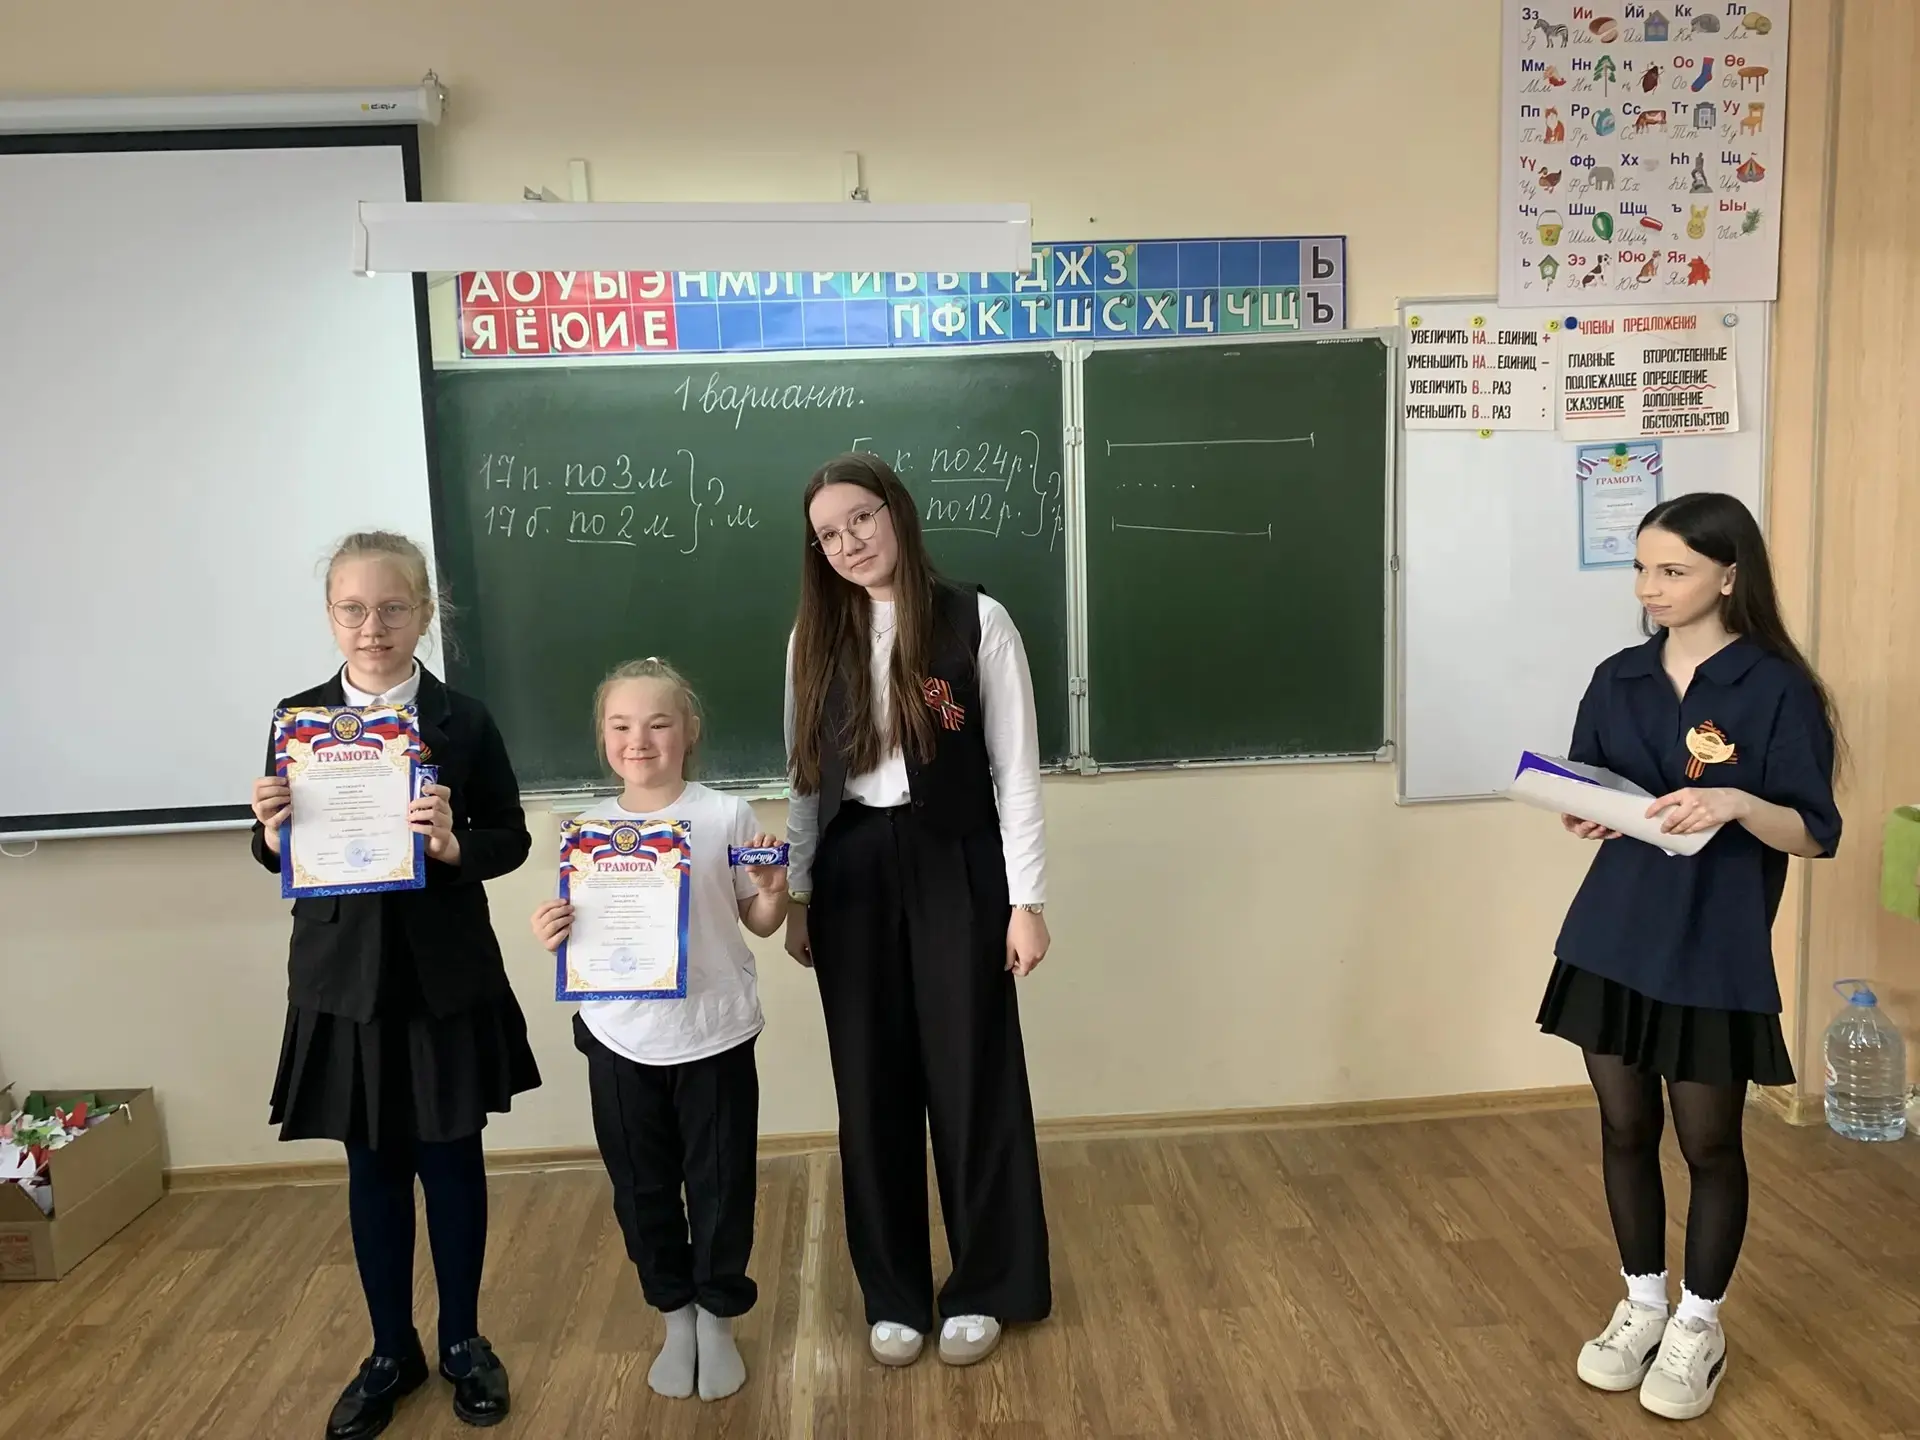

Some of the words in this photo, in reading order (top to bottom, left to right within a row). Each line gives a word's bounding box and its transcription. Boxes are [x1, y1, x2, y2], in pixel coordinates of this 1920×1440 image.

[1522, 8, 1539, 20] Зз
[1573, 7, 1593, 19] Ии
[1625, 4, 1644, 18] Йй
[1675, 5, 1692, 17] Кк
[1726, 3, 1746, 16] Лл
[1521, 59, 1545, 72] Мм
[1572, 58, 1591, 71] Нн
[1673, 56, 1694, 68] Оо
[1521, 105, 1540, 118] Пп
[1571, 104, 1590, 119] Рр
[1622, 103, 1641, 115] Сс
[1672, 102, 1688, 114] Тт
[1723, 100, 1740, 117] Уу
[1570, 155, 1595, 170] Фф
[1621, 153, 1639, 166] Хх
[1721, 151, 1741, 165] Цц
[1519, 204, 1537, 216] Чч
[1569, 203, 1595, 216] Шш
[1620, 202, 1648, 215] Щщ
[1719, 199, 1746, 211] Ыы
[1568, 254, 1586, 266] Ээ
[1618, 251, 1646, 263] Юю
[1667, 251, 1686, 263] Яя
[1579, 319, 1614, 335] ЧЛЕНЫ
[1623, 315, 1697, 333] ПРЕДЛОЖЕНИЯ
[1410, 330, 1468, 345] УВЕЛИЧИТЬ
[1498, 331, 1538, 346] ЕДИНИЦ
[1407, 355, 1468, 369] УМЕНЬШИТЬ
[1498, 355, 1537, 371] ЕДИНИЦ
[1568, 352, 1615, 368] ГЛАВНЫЕ
[1643, 347, 1727, 364] ВТОРОСТЕПЕННЫЕ
[1565, 372, 1637, 390] ПОДЛЕЖАЩЕЕ
[1643, 369, 1708, 386] ОПРЕДЕЛЕНИЕ
[1409, 380, 1467, 395] УВЕЛИЧИТЬ
[674, 376, 691, 412] 1
[699, 371, 865, 430] вариант.
[1566, 395, 1624, 412] СКАЗУЕМОЕ
[1642, 391, 1703, 408] ДОПОЛНЕНИЕ
[1406, 405, 1466, 419] УМЕНЬШИТЬ
[1642, 411, 1729, 429] ОБСТОЯТЕЛЬСТВО
[1595, 475, 1642, 485] ГРАМОТА
[317, 750, 380, 763] ГРАМОТА
[597, 862, 653, 873] ГРАМОТА
